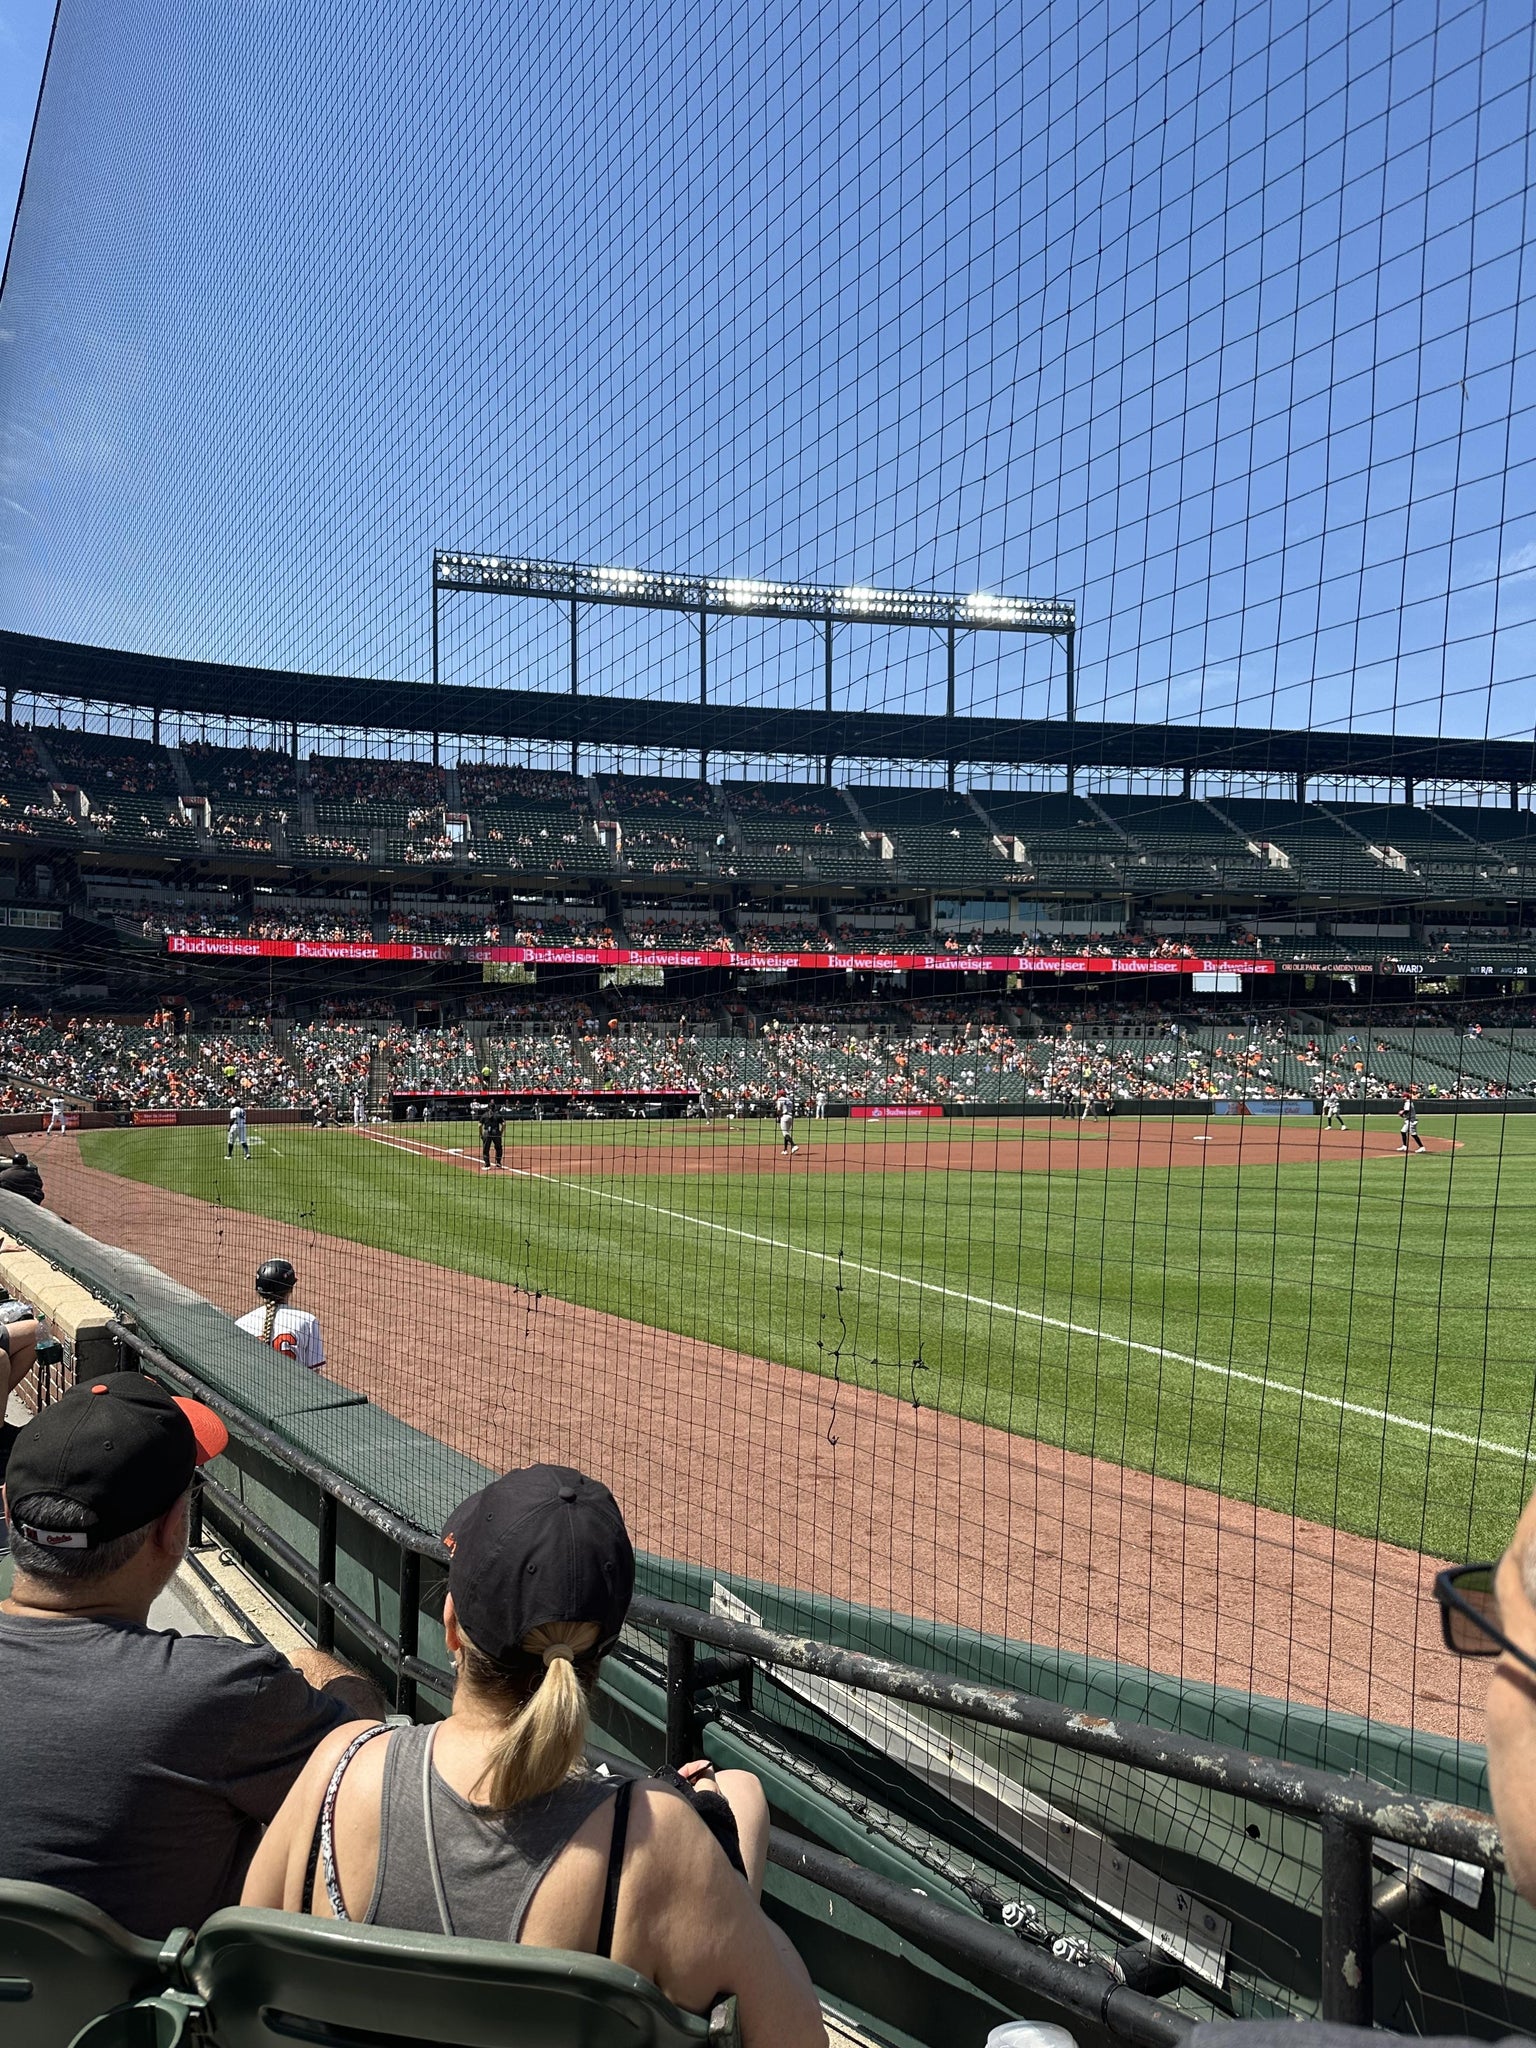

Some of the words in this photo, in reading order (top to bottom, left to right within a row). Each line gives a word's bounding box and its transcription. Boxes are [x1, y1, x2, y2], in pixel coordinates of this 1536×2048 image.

[1328, 964, 1354, 972] CAMDEN
[1397, 964, 1423, 973] WARD
[1481, 966, 1493, 975] R/R
